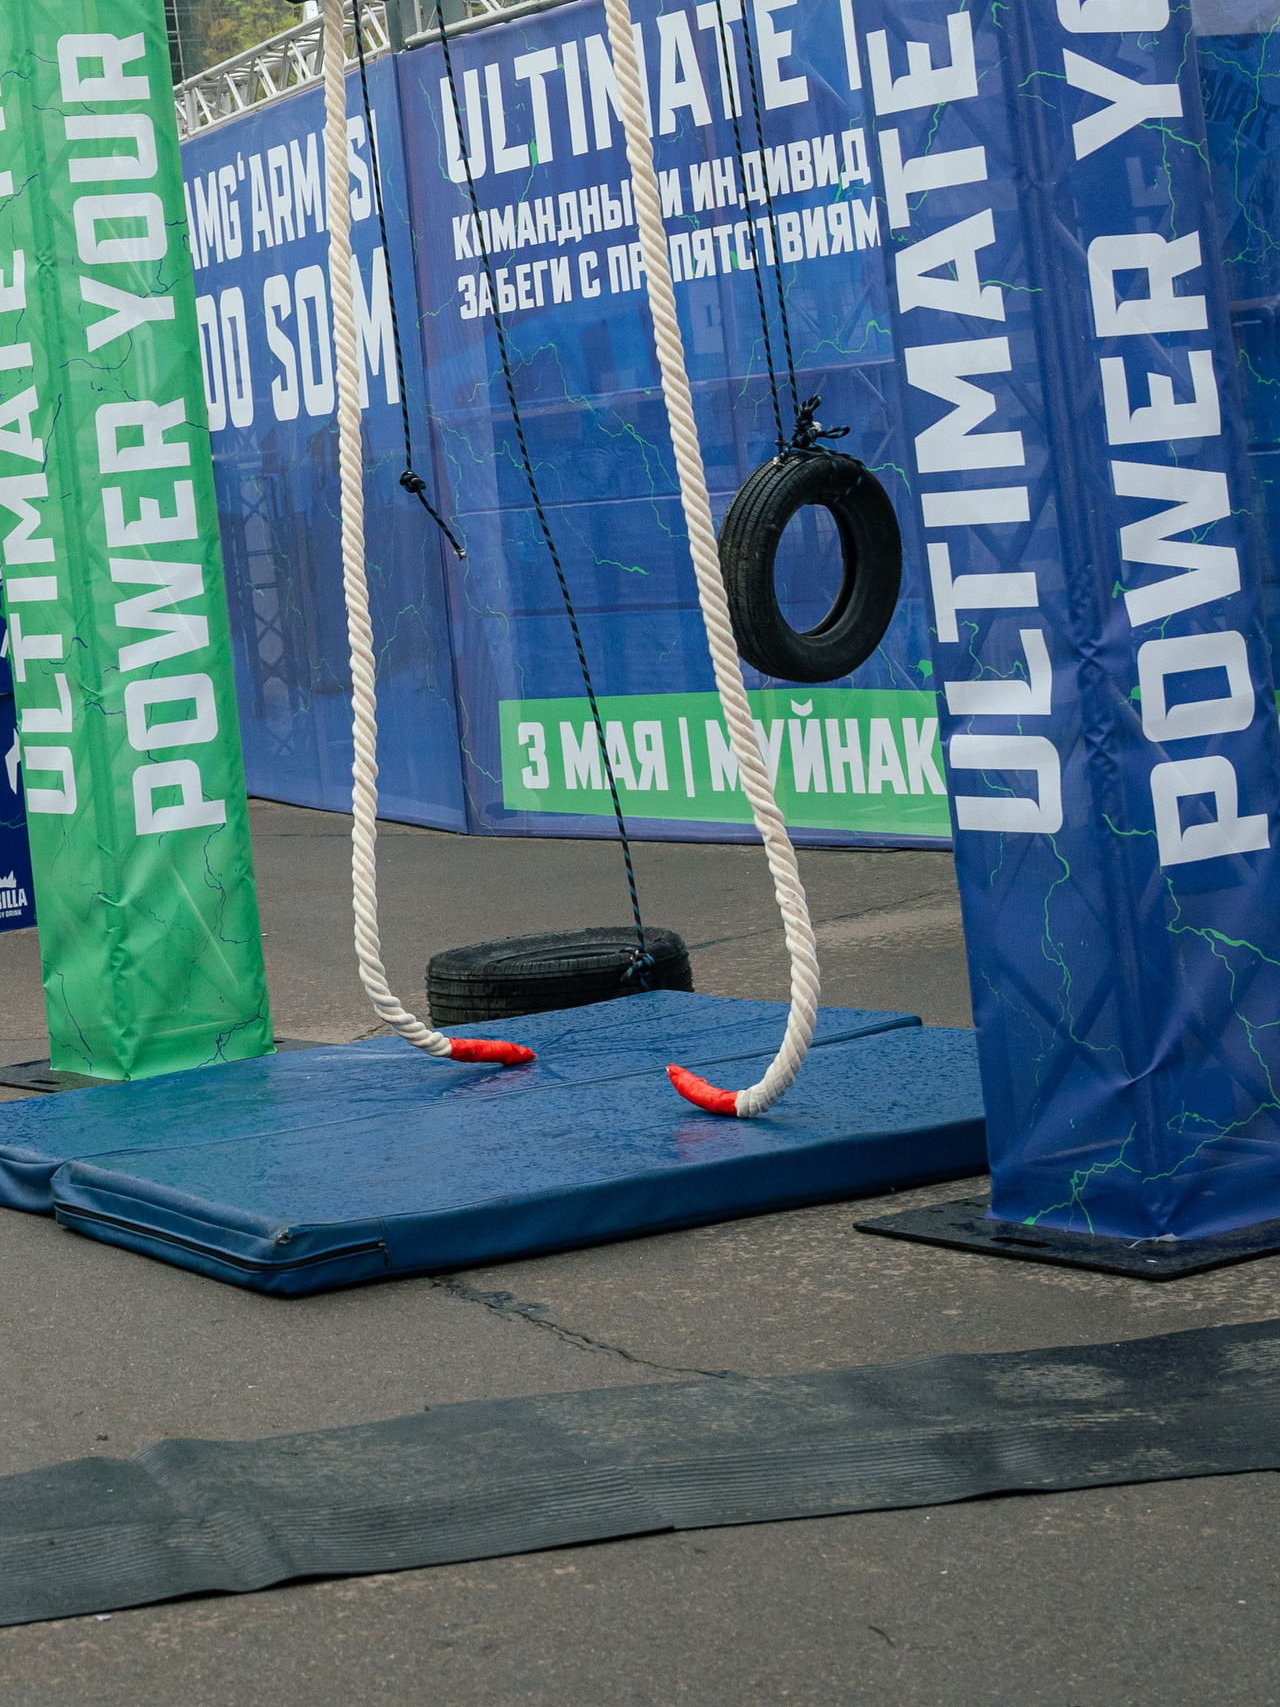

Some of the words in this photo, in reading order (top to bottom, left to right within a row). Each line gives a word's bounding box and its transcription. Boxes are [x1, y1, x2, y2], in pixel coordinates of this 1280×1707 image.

[57, 32, 175, 352] YOUR
[452, 178, 639, 261] КОМАНДНЫ
[658, 168, 684, 219] И
[457, 255, 574, 321] ЗАБЕГИ
[578, 250, 601, 300] С
[607, 195, 882, 295] ПРПЯТСТВИЯМ
[866, 10, 1063, 834] ULTIMATE
[96, 397, 227, 835] POWER
[1087, 232, 1270, 867] POWER
[517, 721, 550, 790] 3
[559, 720, 669, 791] МАЯ
[705, 698, 948, 795] МУЙНАК
[5, 909, 22, 918] DRINK
